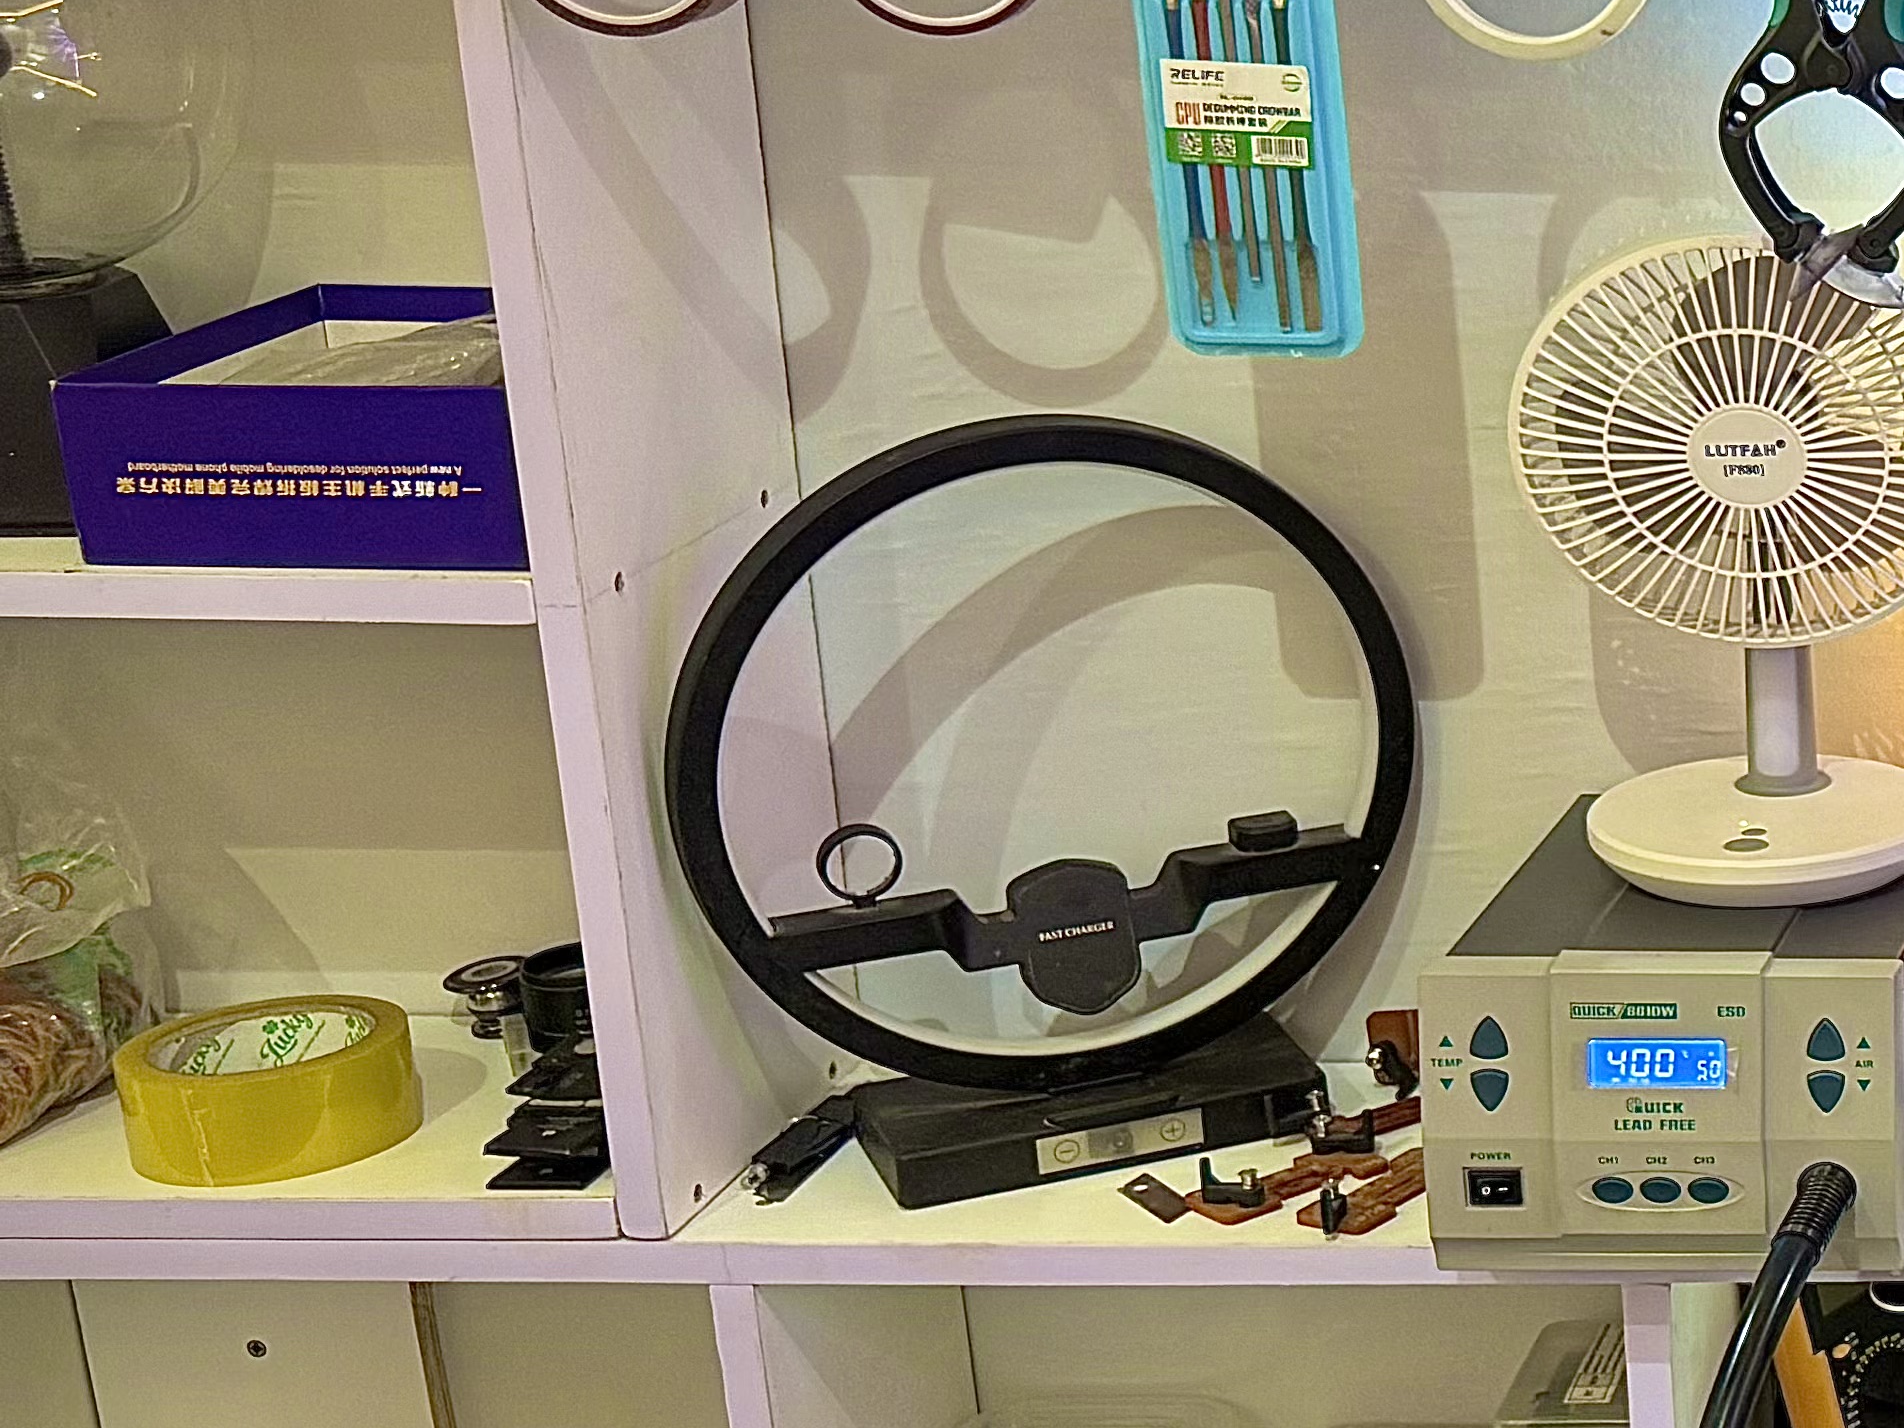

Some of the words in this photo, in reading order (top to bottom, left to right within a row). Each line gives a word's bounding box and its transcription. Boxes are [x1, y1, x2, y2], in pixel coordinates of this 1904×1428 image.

[1175, 101, 1201, 126] CPU
[1704, 444, 1776, 457] LUTFAH
[1717, 1006, 1746, 1018] ESD
[1430, 1058, 1462, 1068] TEMP
[1606, 1049, 1674, 1079] 400
[1854, 1059, 1874, 1068] AIR
[1614, 1119, 1653, 1131] LEAD
[1659, 1119, 1696, 1131] FREE
[1470, 1152, 1511, 1160] POWER
